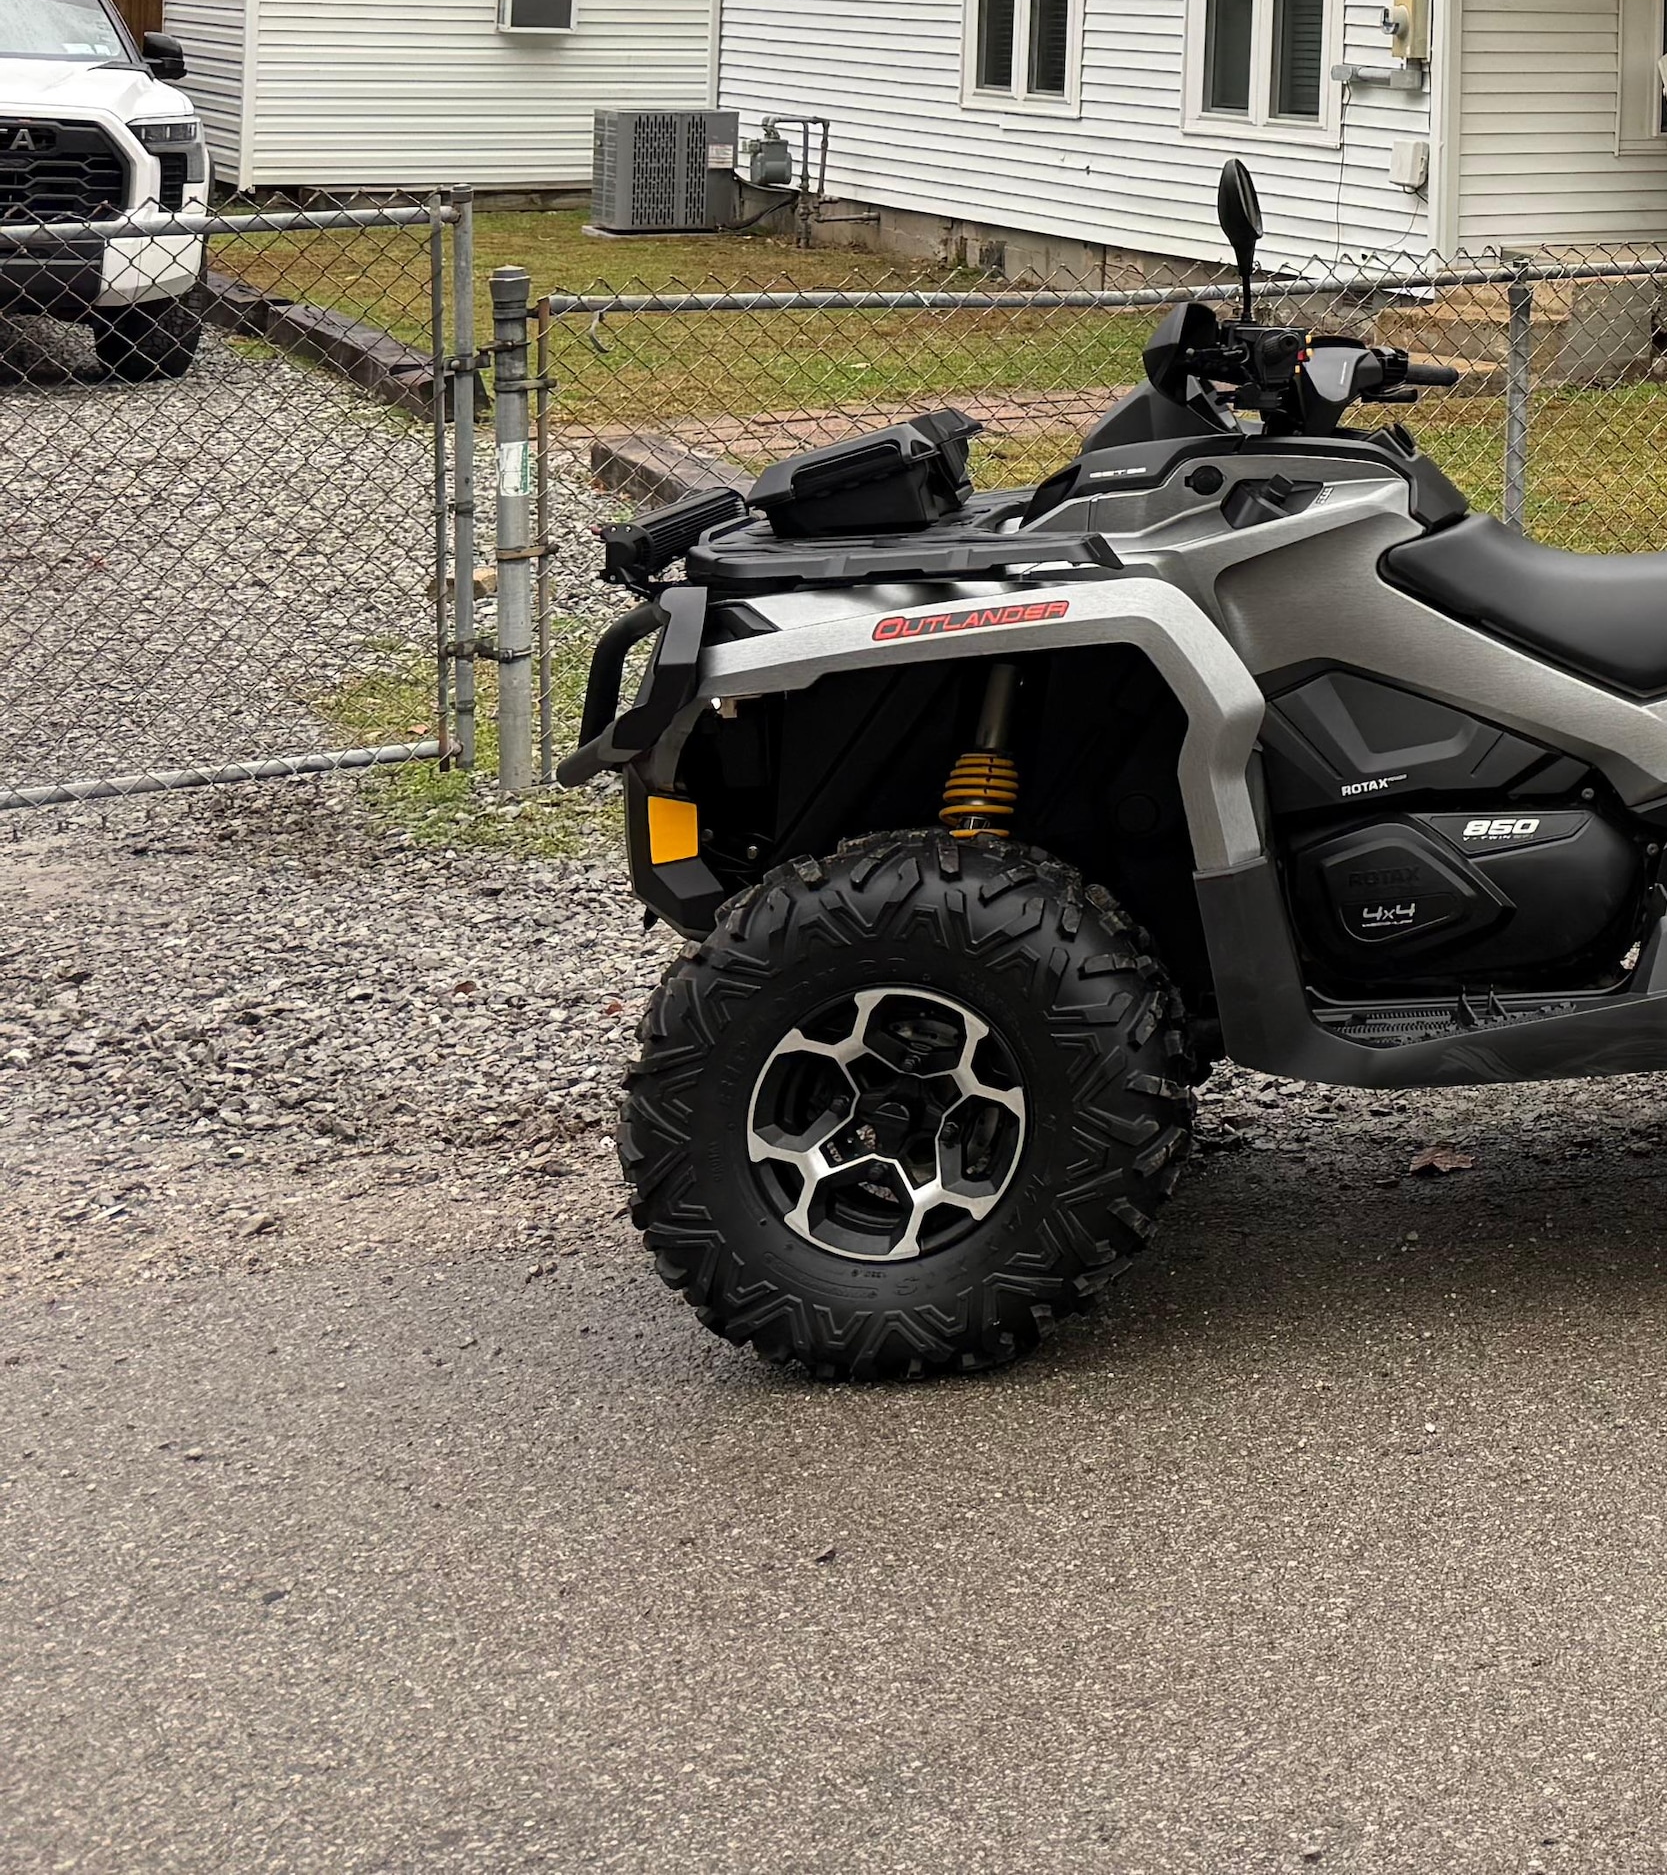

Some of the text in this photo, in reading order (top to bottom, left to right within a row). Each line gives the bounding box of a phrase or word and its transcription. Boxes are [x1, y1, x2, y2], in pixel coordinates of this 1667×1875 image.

[872, 600, 1070, 641] OUTLANDER
[1341, 777, 1389, 796] ROTAX
[1463, 819, 1540, 836] 850
[1362, 902, 1416, 921] 4x4
